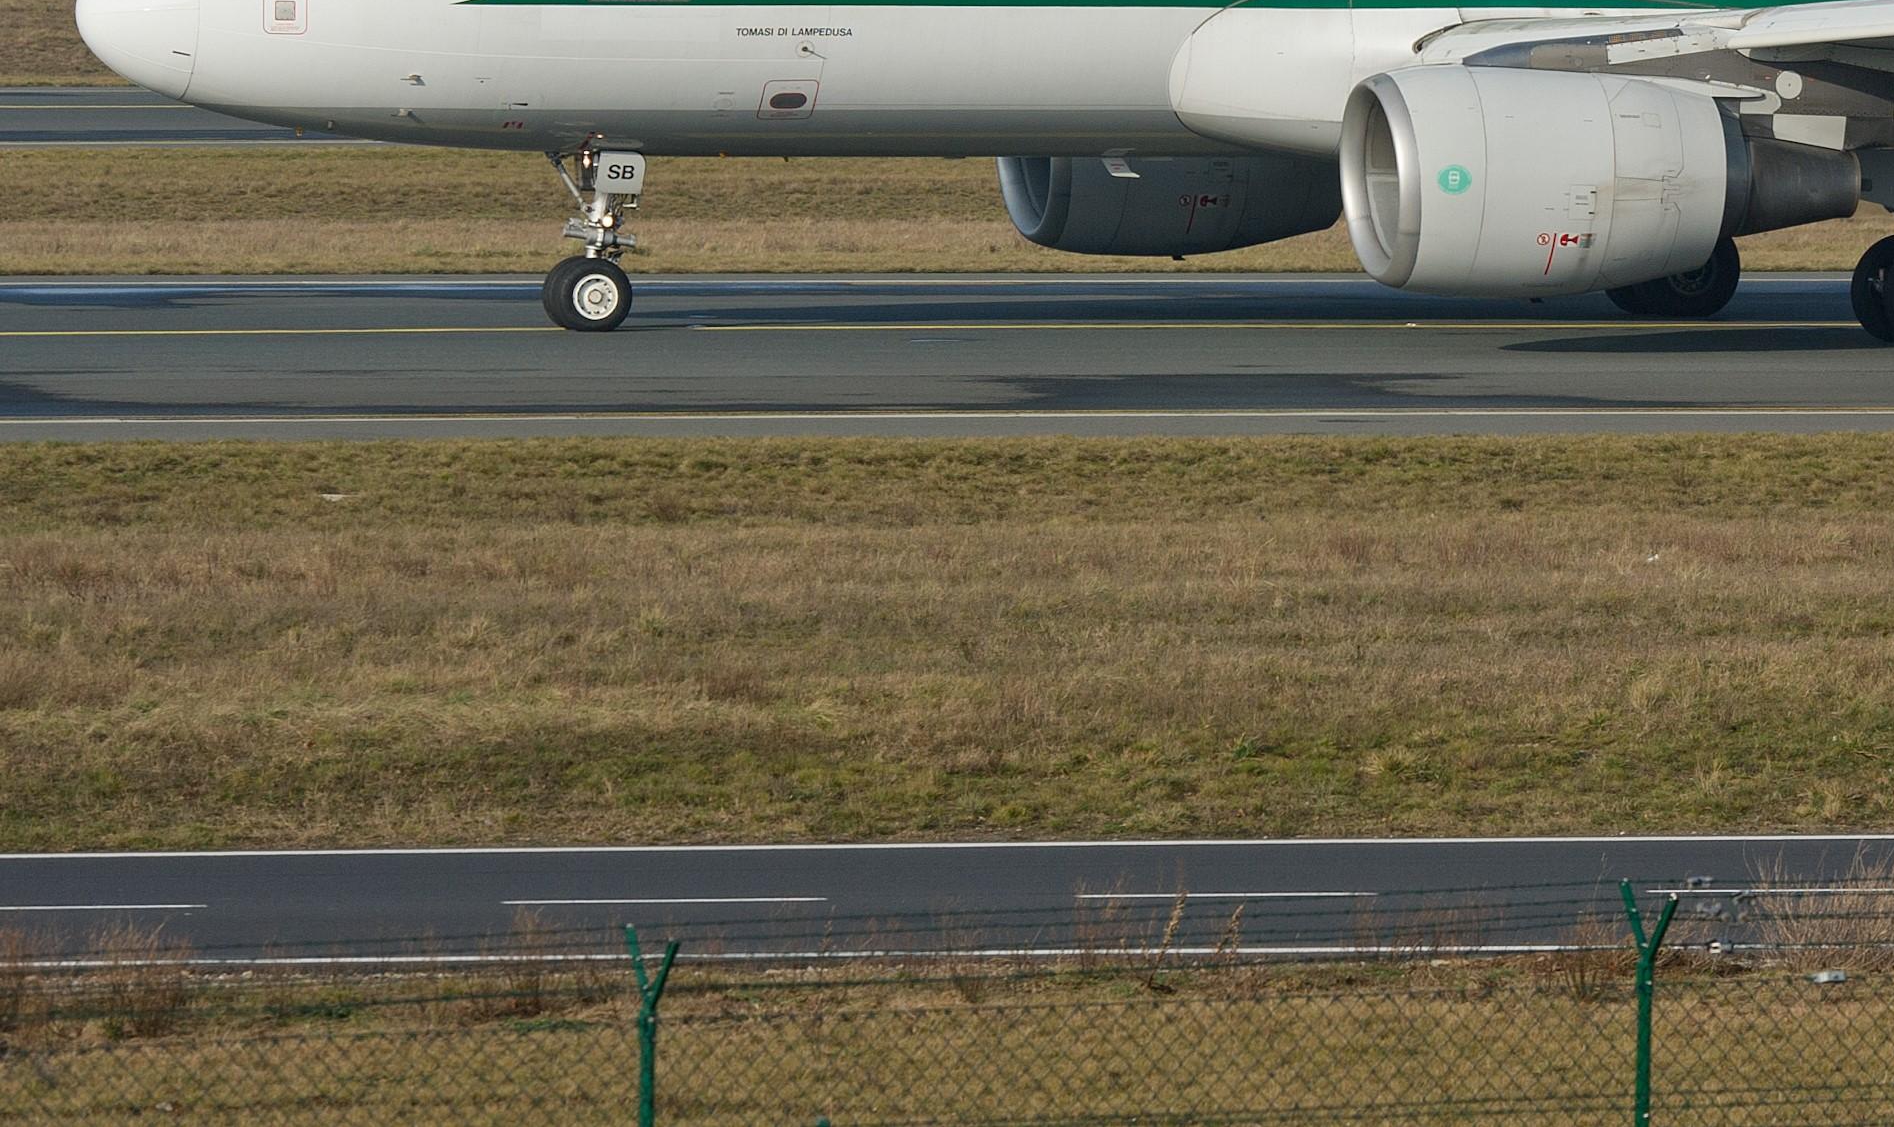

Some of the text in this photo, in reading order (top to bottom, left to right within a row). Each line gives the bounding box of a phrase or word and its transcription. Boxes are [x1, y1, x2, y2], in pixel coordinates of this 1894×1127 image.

[736, 27, 853, 37] TOMASI DI LAMPEDUSA
[607, 164, 635, 180] SB
